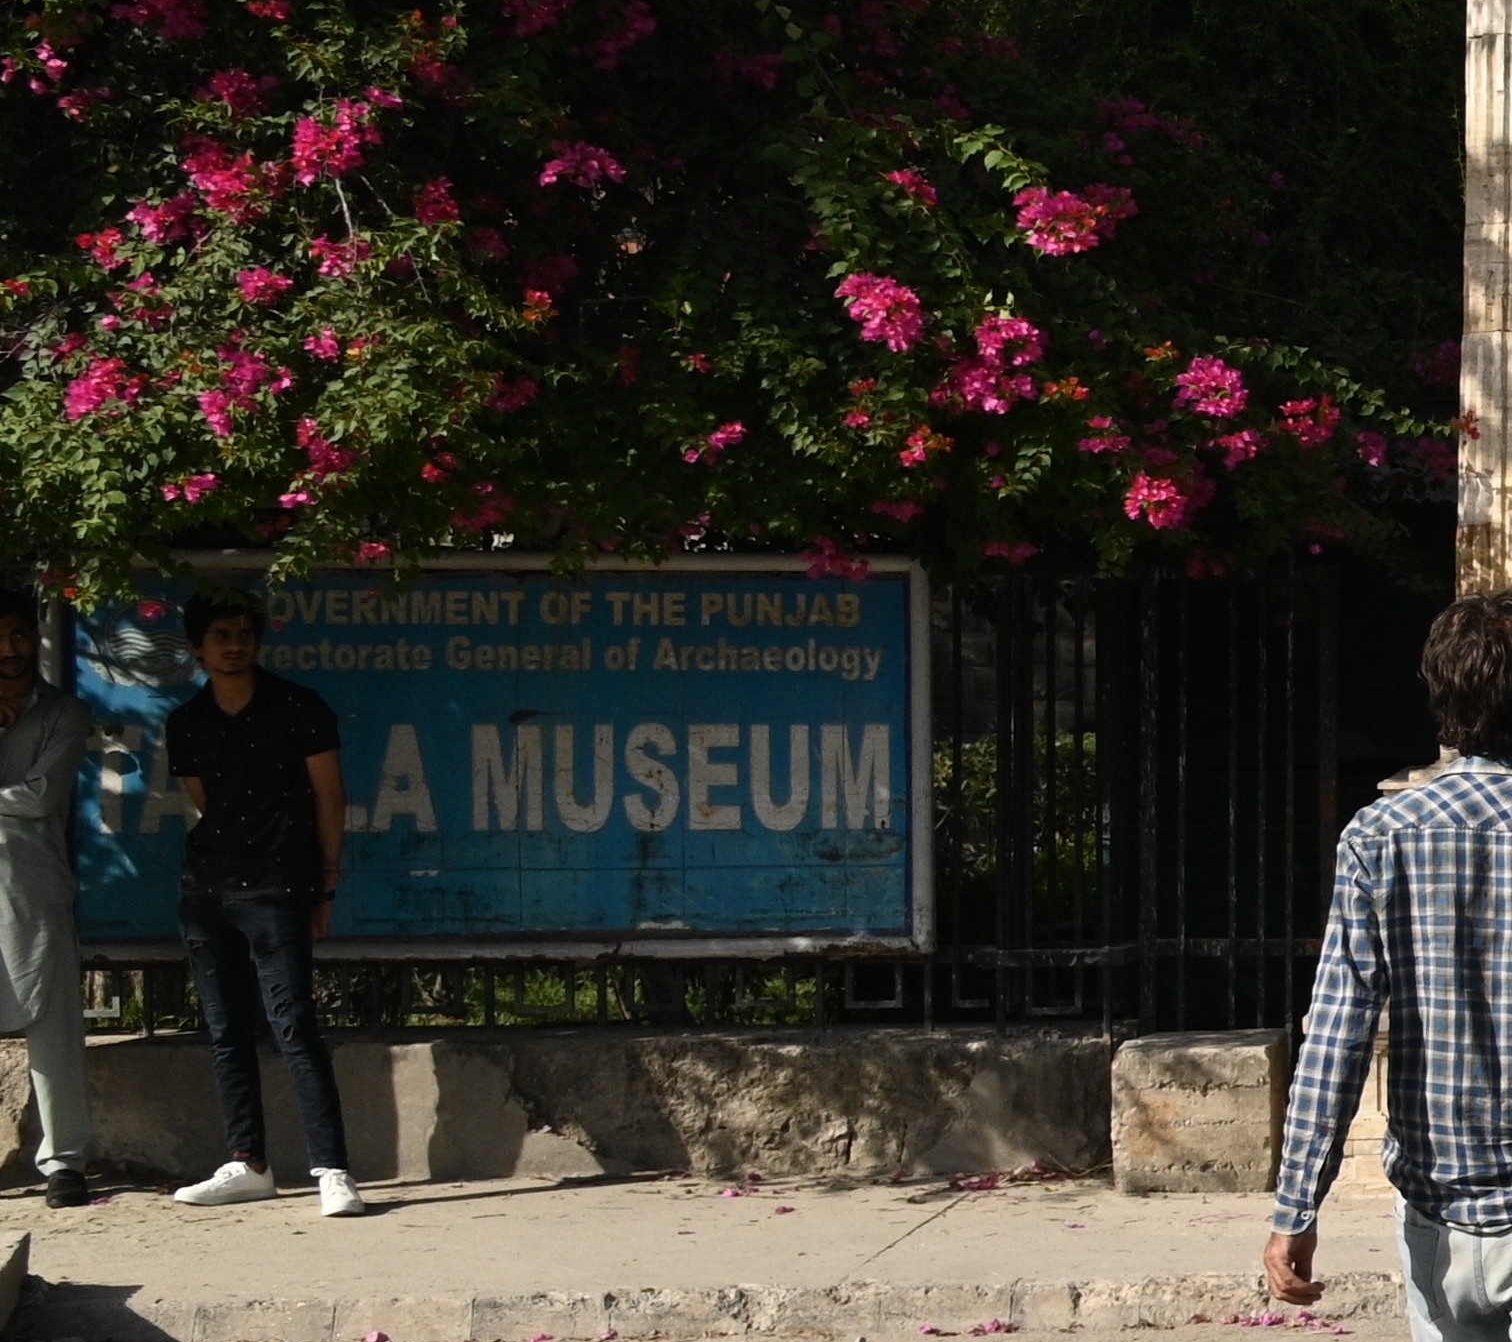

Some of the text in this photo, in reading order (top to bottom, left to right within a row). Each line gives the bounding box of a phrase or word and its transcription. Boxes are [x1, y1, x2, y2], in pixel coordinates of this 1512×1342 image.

[539, 590, 592, 626] OF
[606, 592, 687, 626] THE
[700, 593, 862, 627] PUNJAB
[259, 635, 882, 681] rectorate General of Archaeology
[471, 722, 891, 833] MUSEUM
